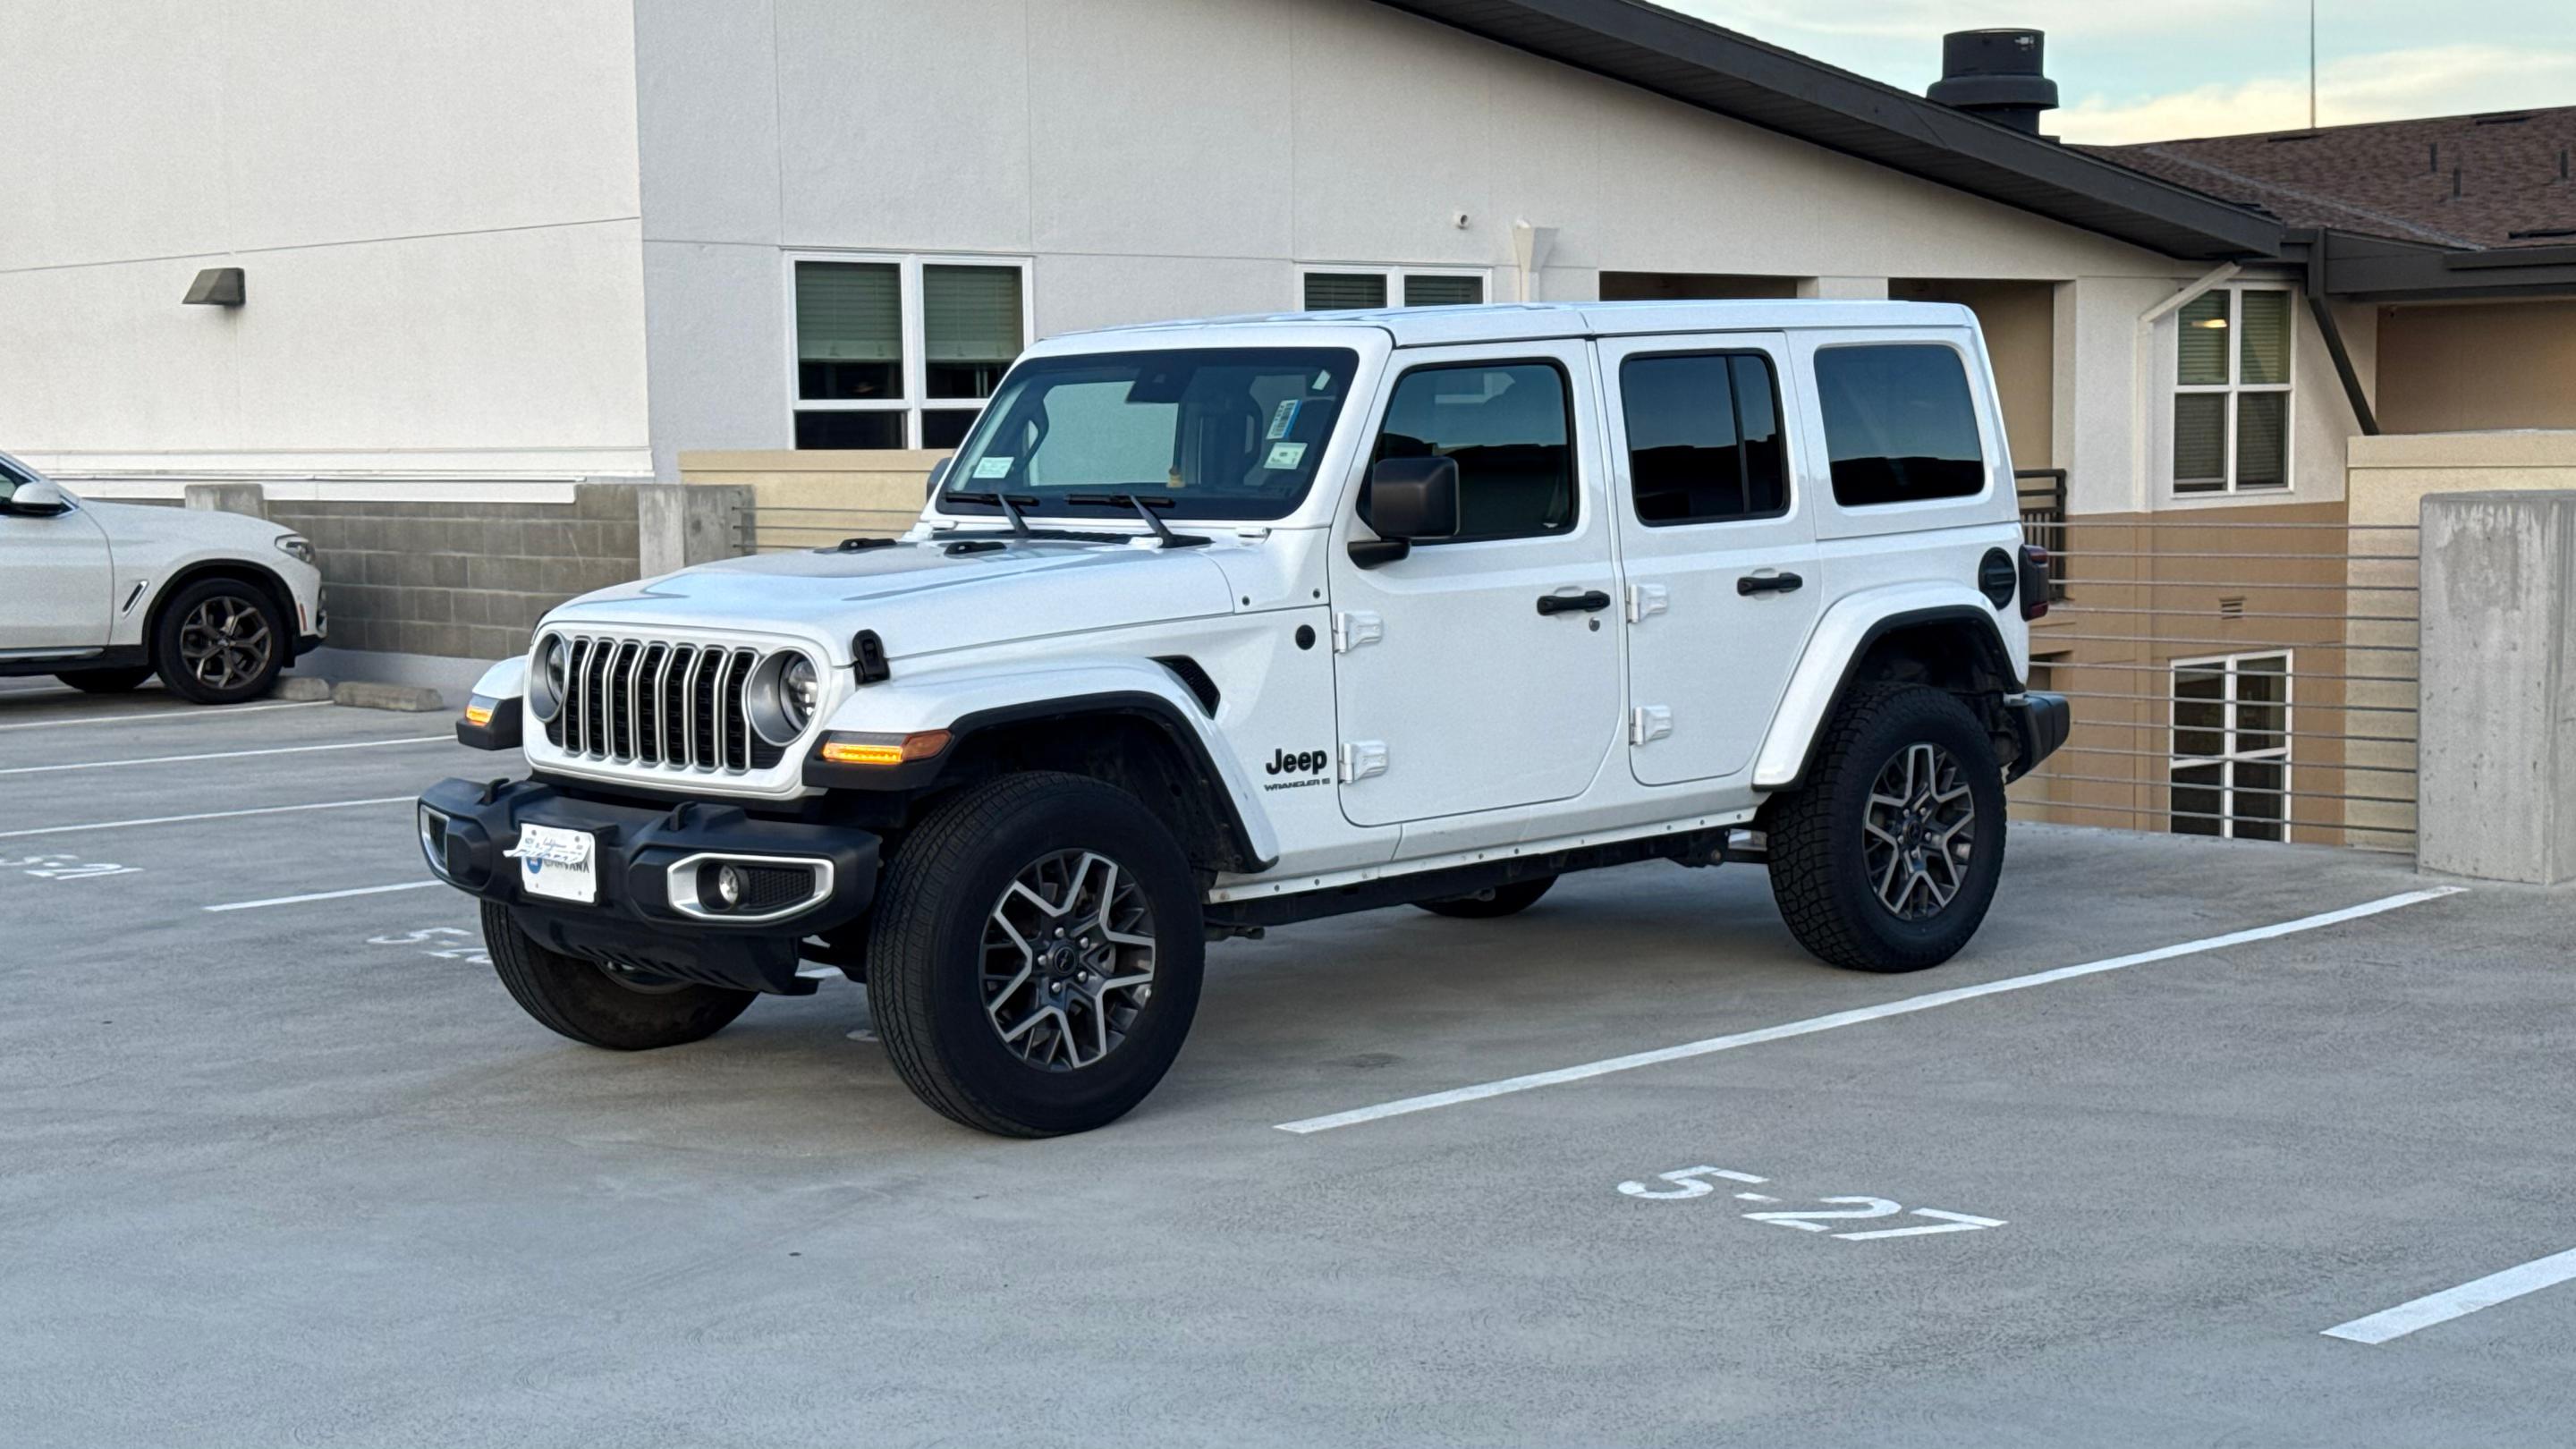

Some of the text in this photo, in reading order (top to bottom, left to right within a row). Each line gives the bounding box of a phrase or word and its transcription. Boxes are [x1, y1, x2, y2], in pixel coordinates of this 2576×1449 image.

[1266, 749, 1327, 775] Jeep
[1264, 778, 1320, 792] WRANGLER
[1617, 1165, 2009, 1241] 5-27
